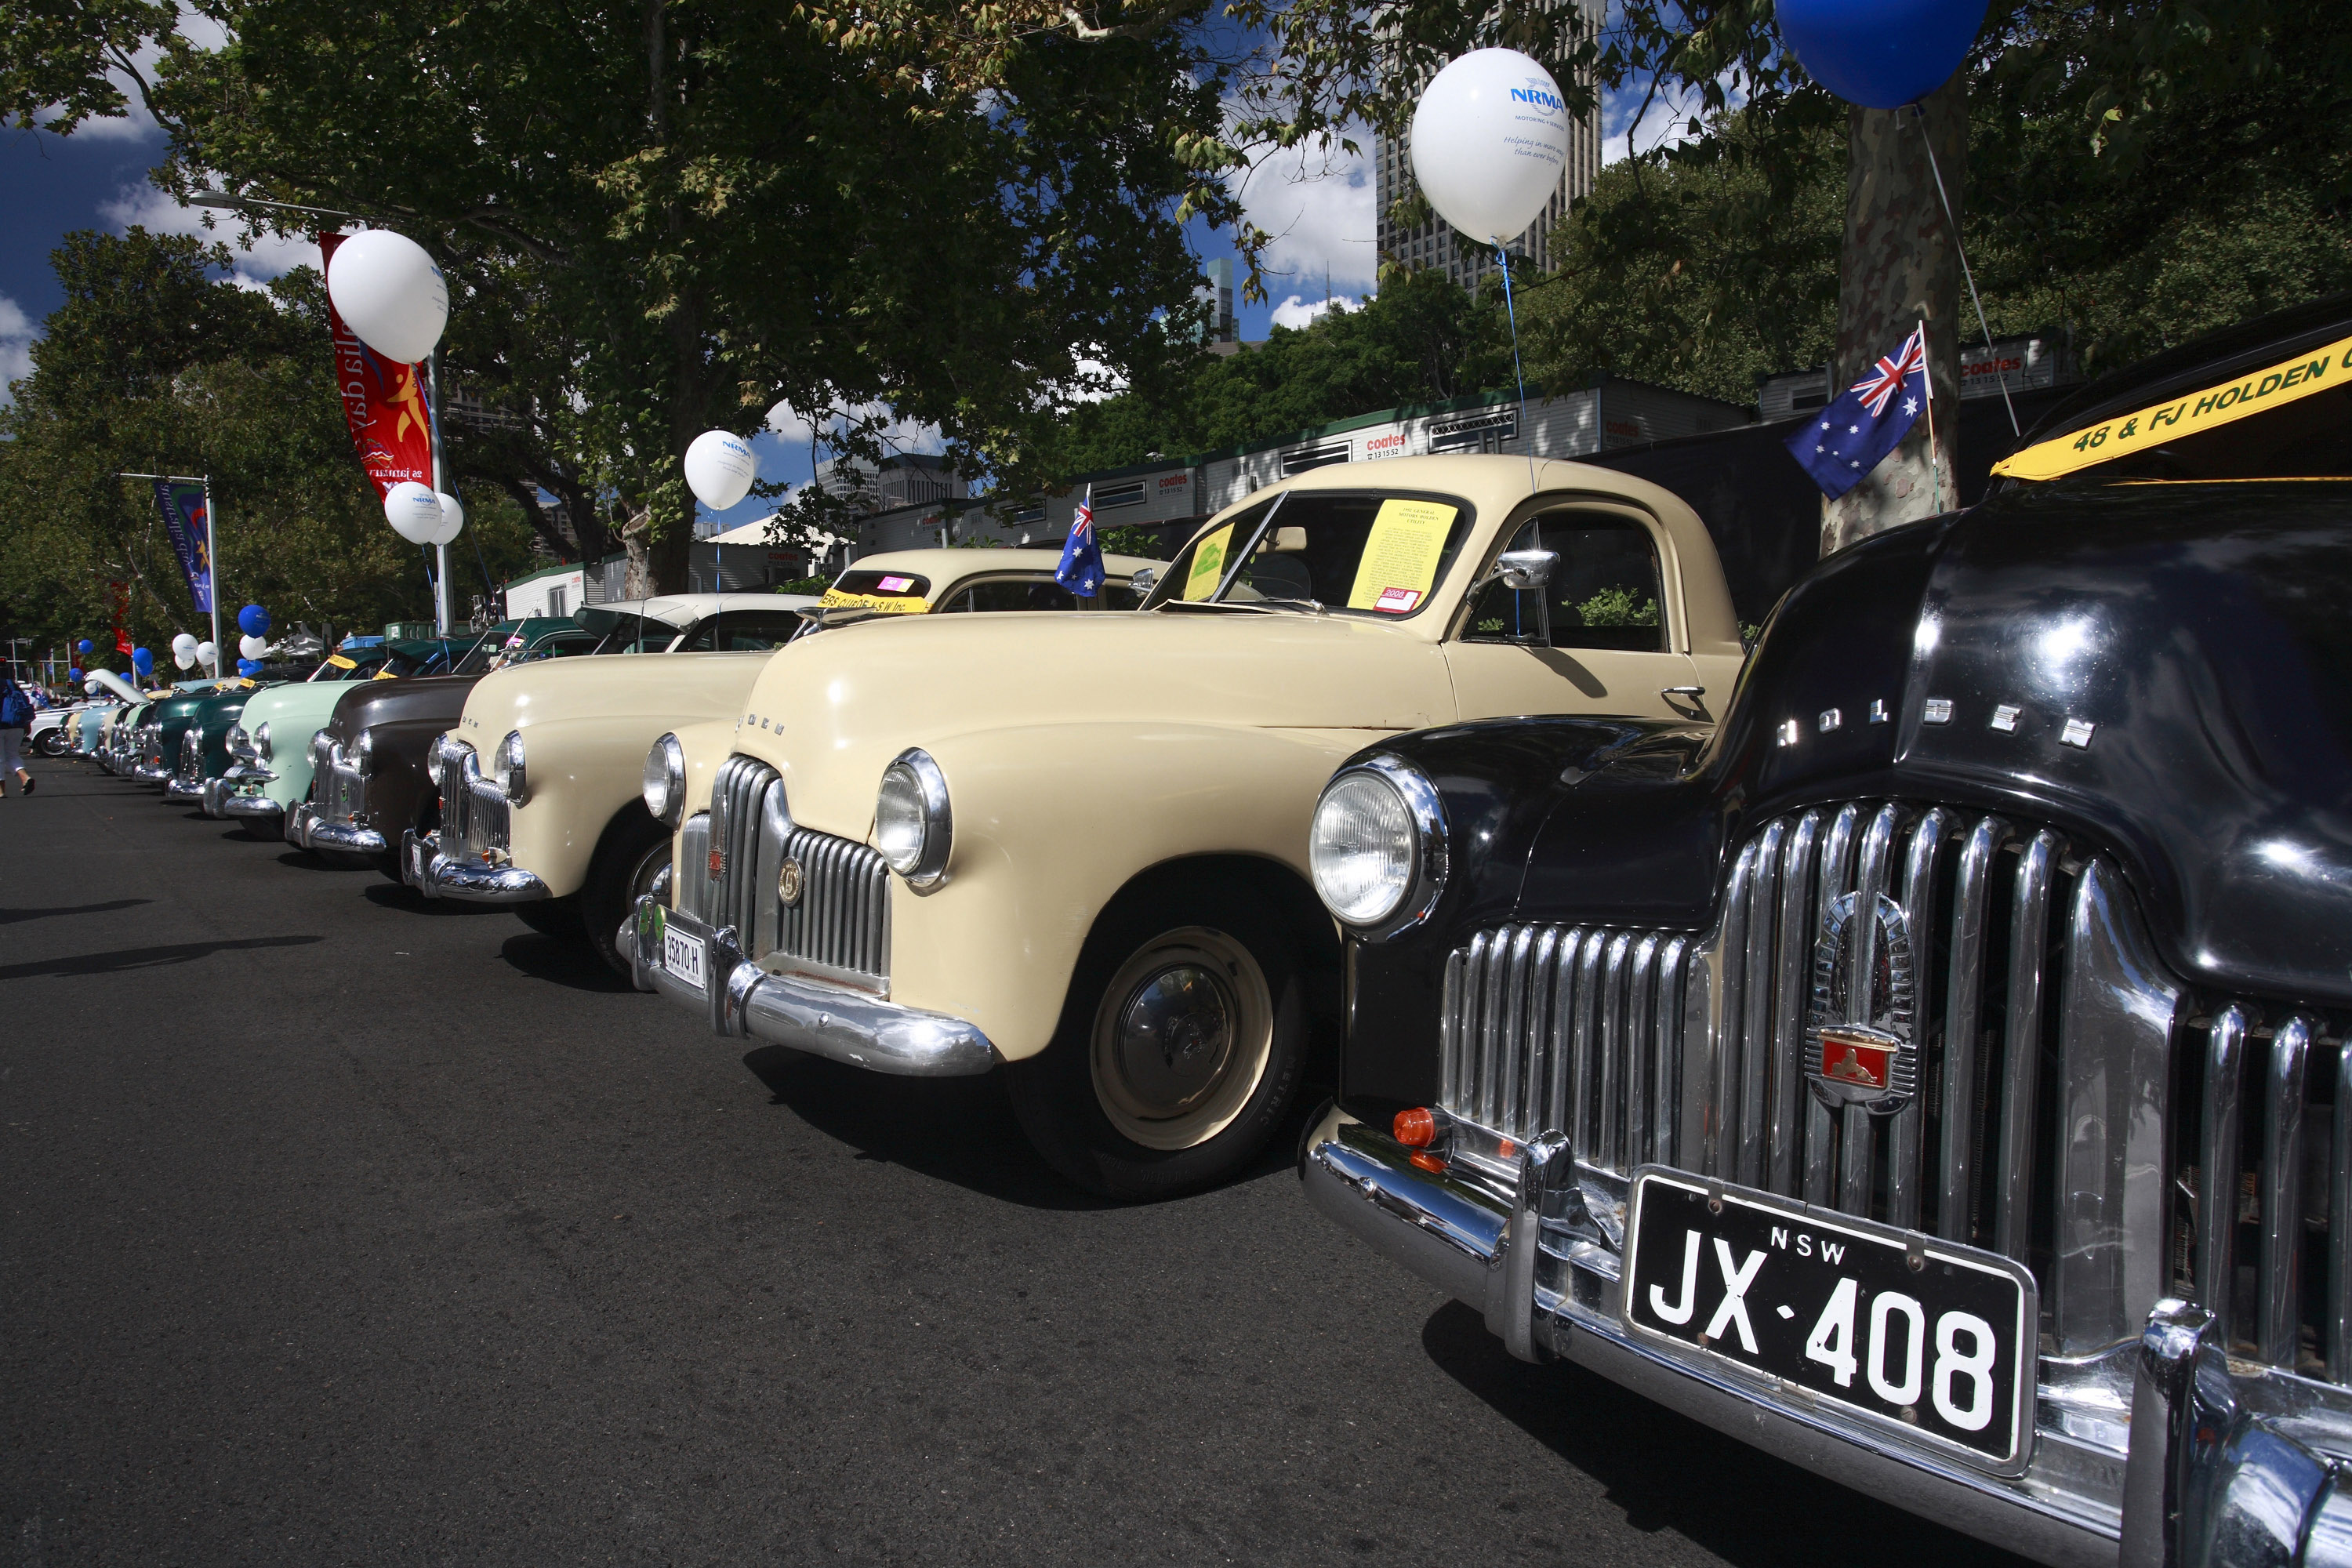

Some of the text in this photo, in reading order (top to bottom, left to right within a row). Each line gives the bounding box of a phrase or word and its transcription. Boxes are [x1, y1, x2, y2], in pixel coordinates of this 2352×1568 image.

[1511, 89, 1564, 114] NRMA
[1515, 115, 1545, 124] MOTORING
[1504, 136, 1534, 149] Helping
[1514, 147, 1533, 156] than
[1960, 357, 2021, 377] coates
[2073, 426, 2111, 452] 48
[2118, 417, 2138, 439] &
[2149, 402, 2187, 430] FJ
[2192, 356, 2331, 418] HOLDEN
[722, 441, 751, 459] NRMA
[1367, 434, 1406, 451] coates
[1160, 474, 1187, 488] coates
[1385, 589, 1405, 598] 2008
[1777, 696, 2097, 751] HOLDEN
[1771, 1226, 1846, 1265] NSW
